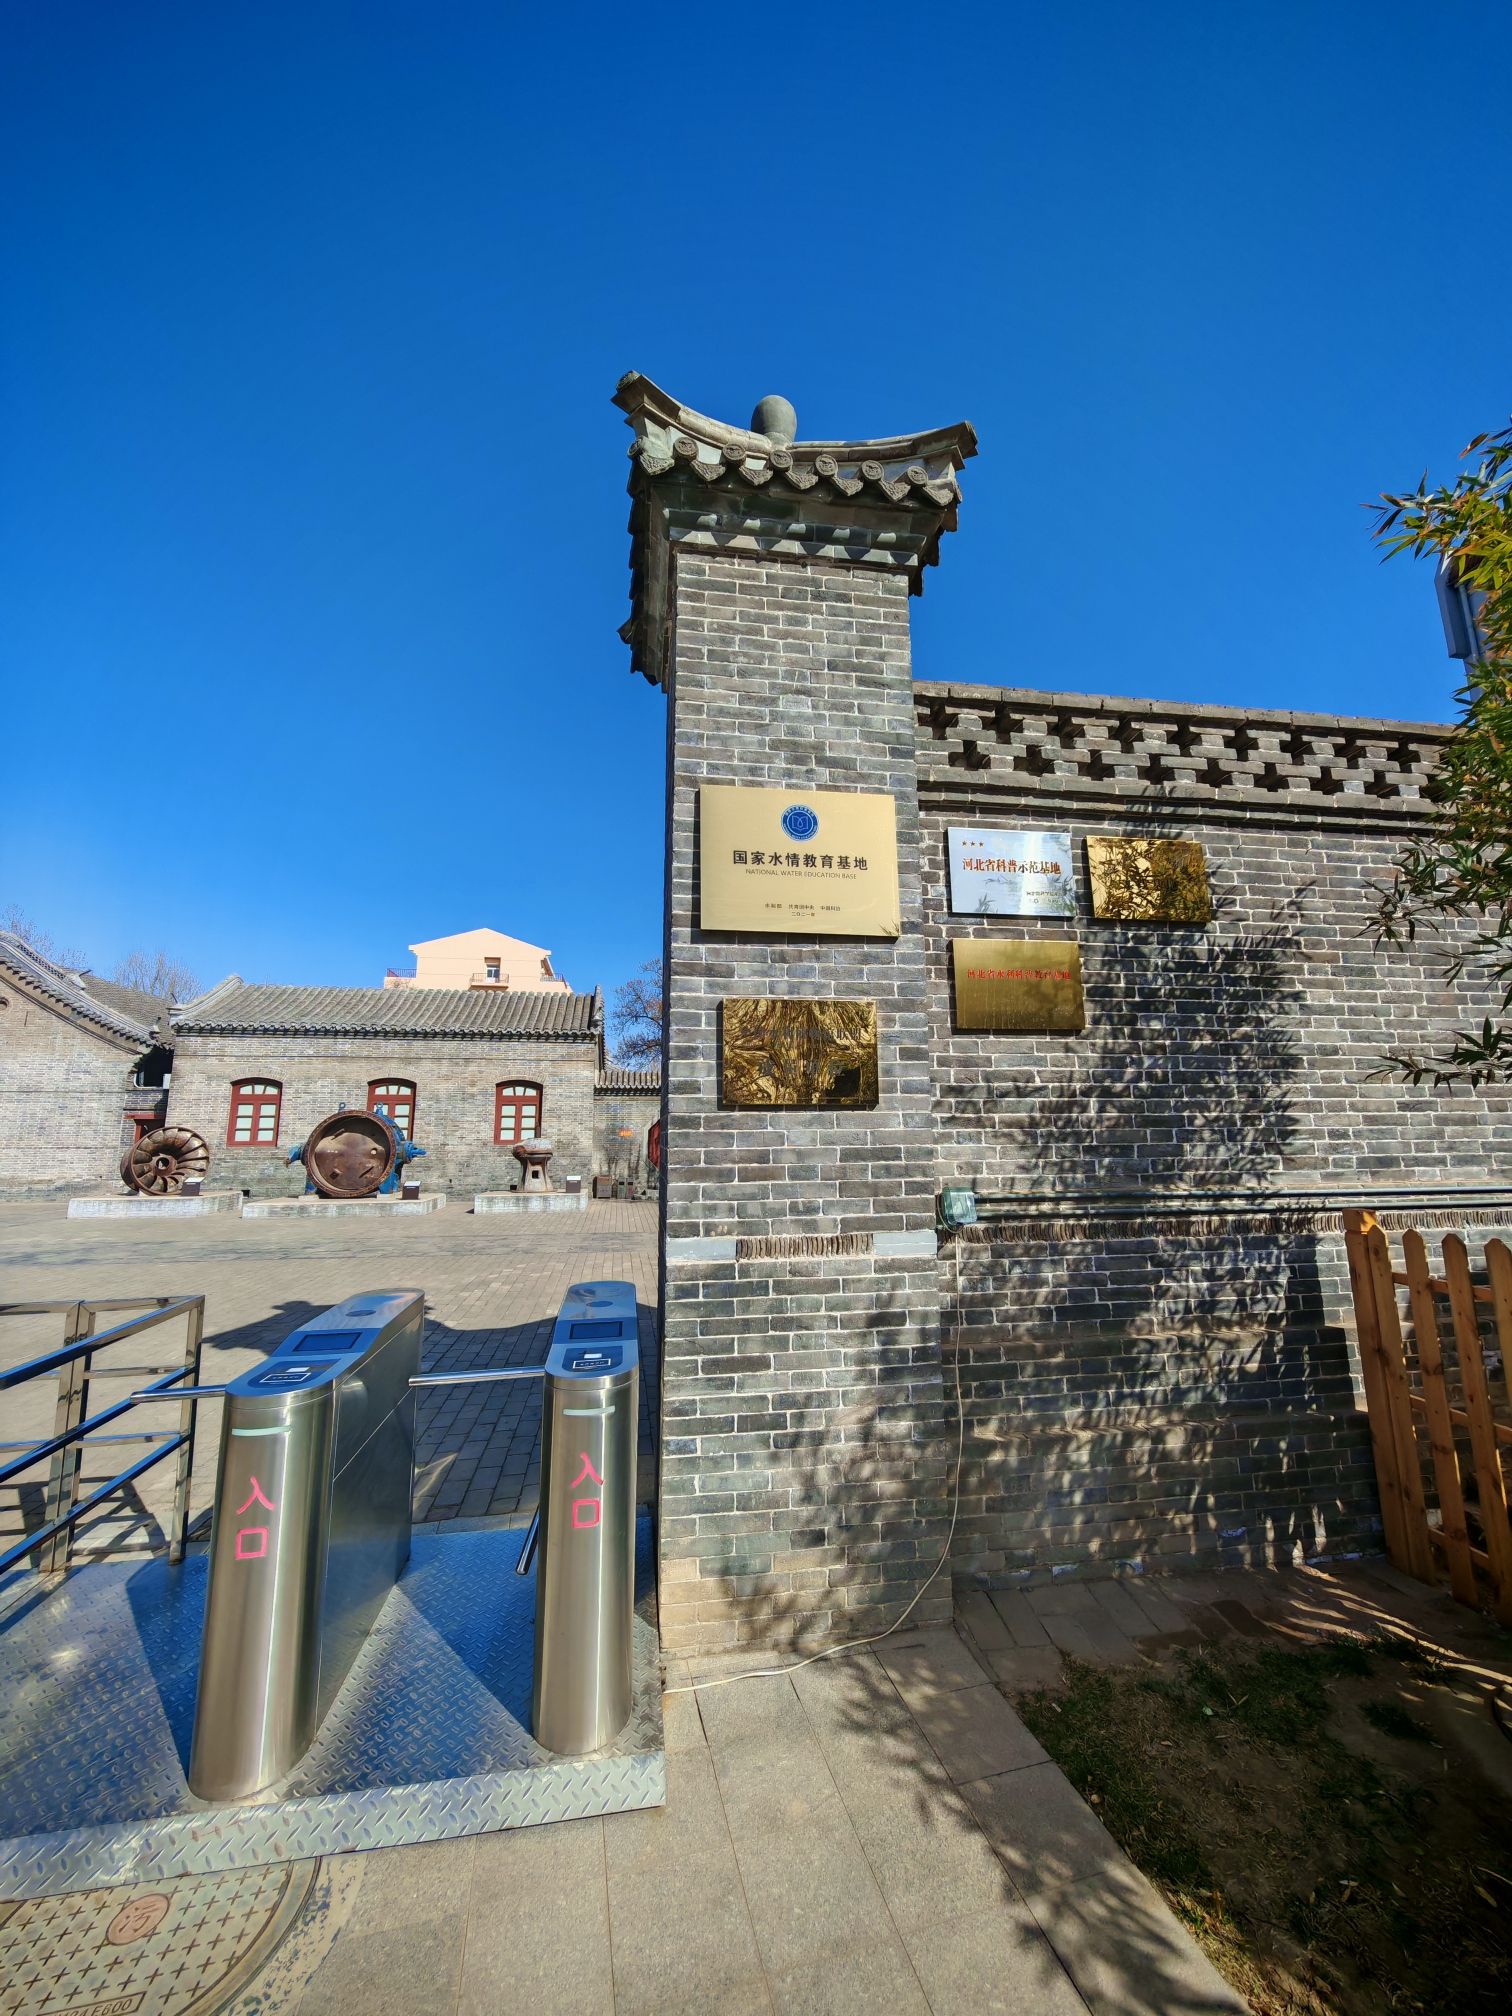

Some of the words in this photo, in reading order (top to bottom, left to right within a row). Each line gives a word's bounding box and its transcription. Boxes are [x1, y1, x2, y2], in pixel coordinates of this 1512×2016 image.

[733, 850, 868, 870] 国家水情教育基地
[962, 858, 1062, 875] 河北省科普示范基地
[745, 868, 779, 876] NATIONAL
[804, 871, 841, 879] EDUCATION
[569, 1452, 605, 1529] 入口
[234, 1475, 276, 1561] 入口
[117, 1904, 158, 1934] 污
